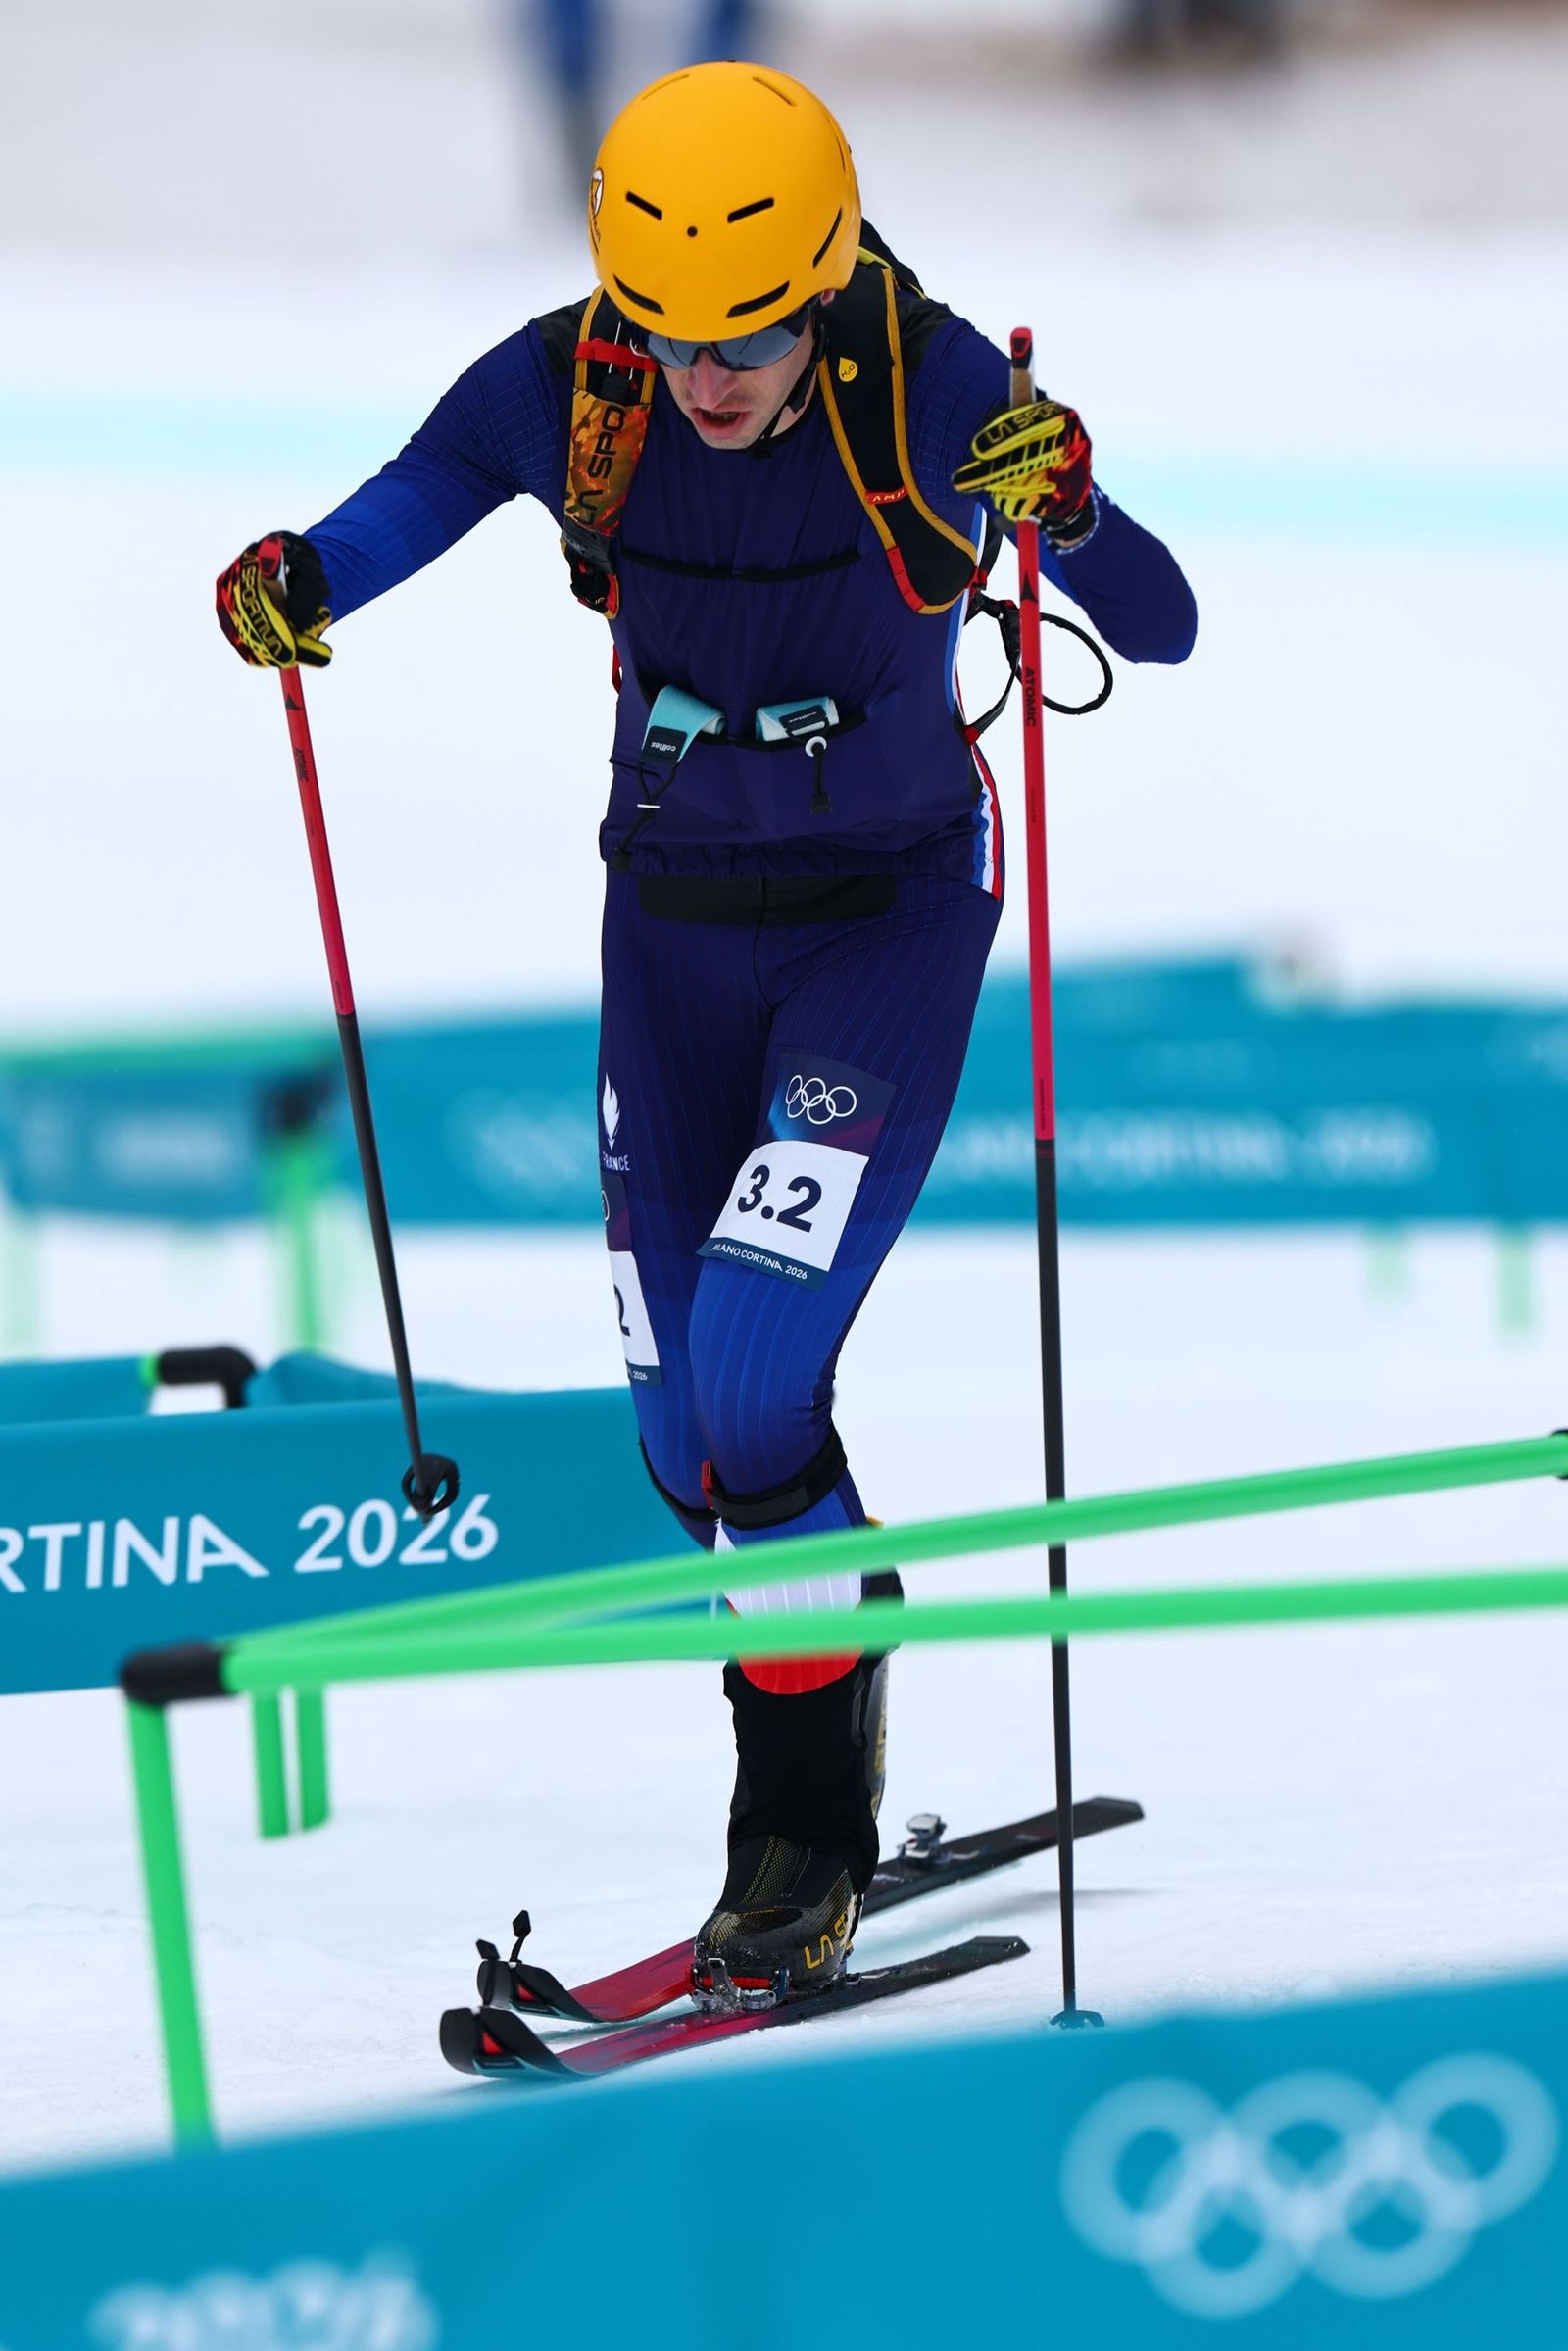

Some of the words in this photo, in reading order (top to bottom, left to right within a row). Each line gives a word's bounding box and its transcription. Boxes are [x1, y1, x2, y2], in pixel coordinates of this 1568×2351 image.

[986, 423, 1013, 443] LA
[1025, 667, 1037, 727] ATOMIC
[737, 1164, 822, 1233] 3.2
[741, 1250, 783, 1271] CORTINA
[784, 1265, 808, 1280] 2026
[293, 1494, 499, 1573] 2026
[804, 1935, 834, 1969] LA
